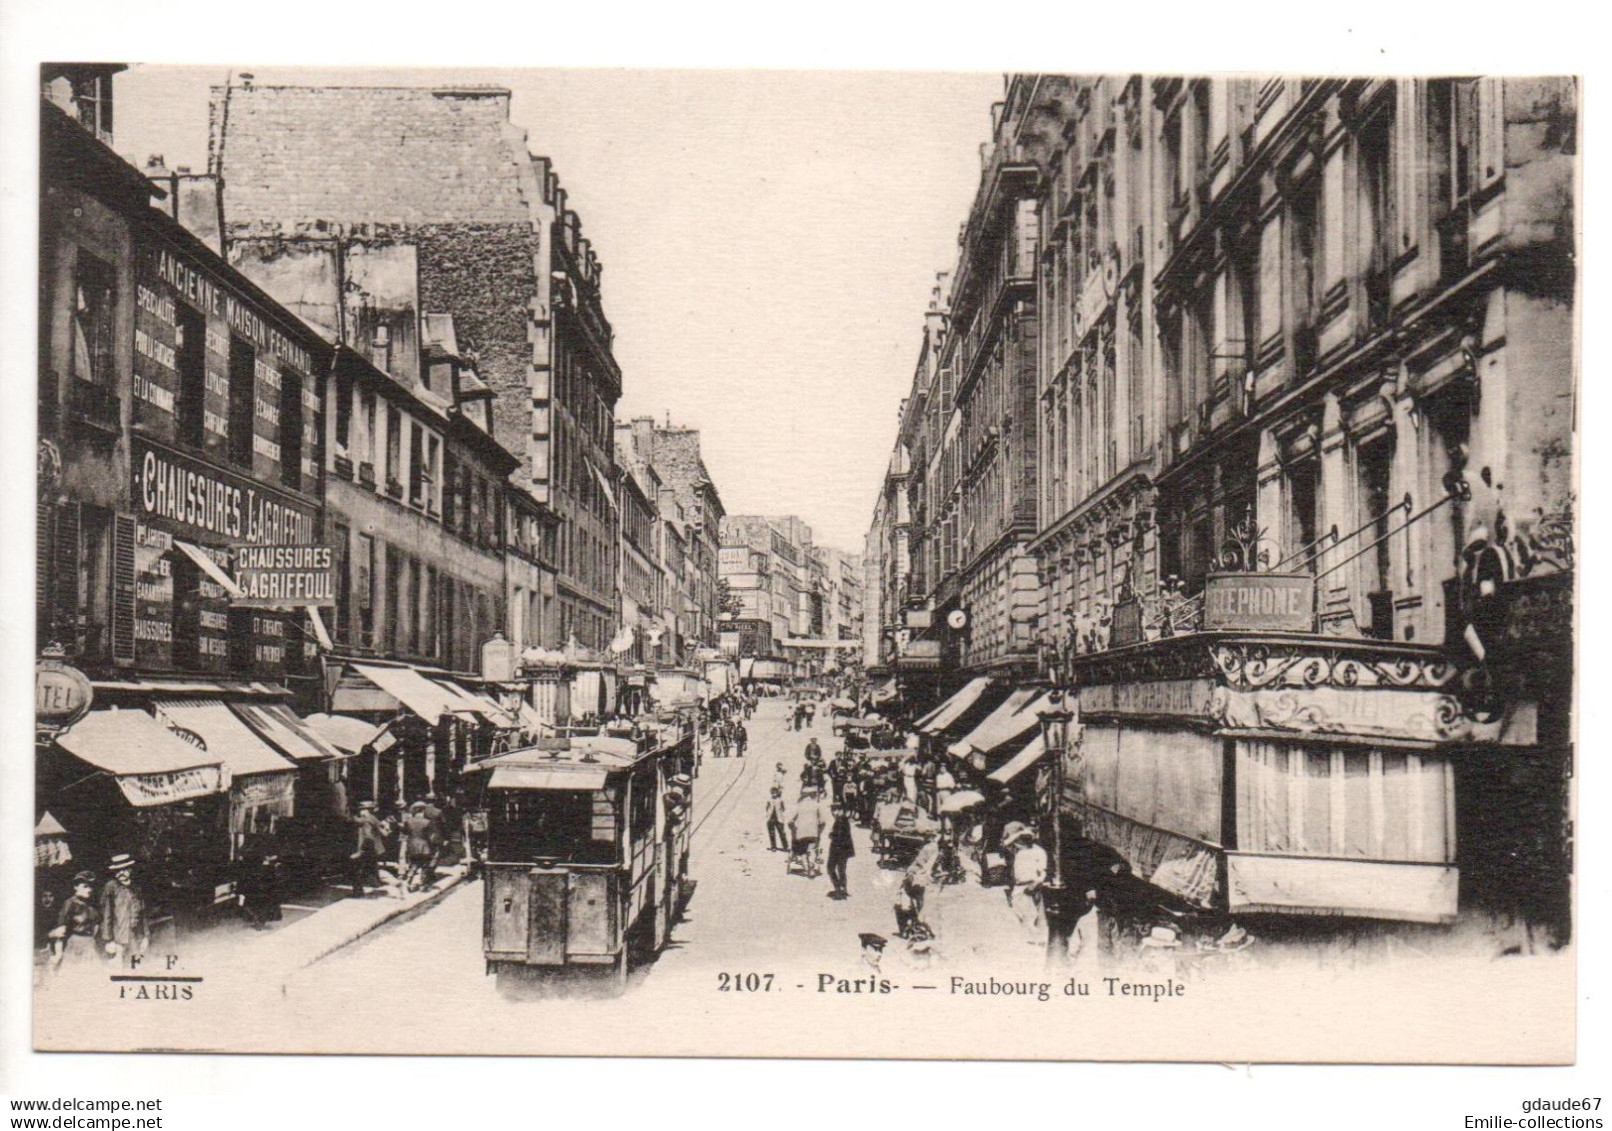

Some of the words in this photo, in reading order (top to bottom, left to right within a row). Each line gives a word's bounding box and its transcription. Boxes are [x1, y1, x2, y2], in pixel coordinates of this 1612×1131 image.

[158, 250, 219, 316] ANCIENNE
[226, 297, 266, 347] MAISON
[142, 451, 241, 538] CHAUSSURES
[246, 489, 313, 546] LAGRIFFOUL
[234, 571, 333, 599] LAGRIFFOUL
[239, 548, 331, 568] CHAUSSURES
